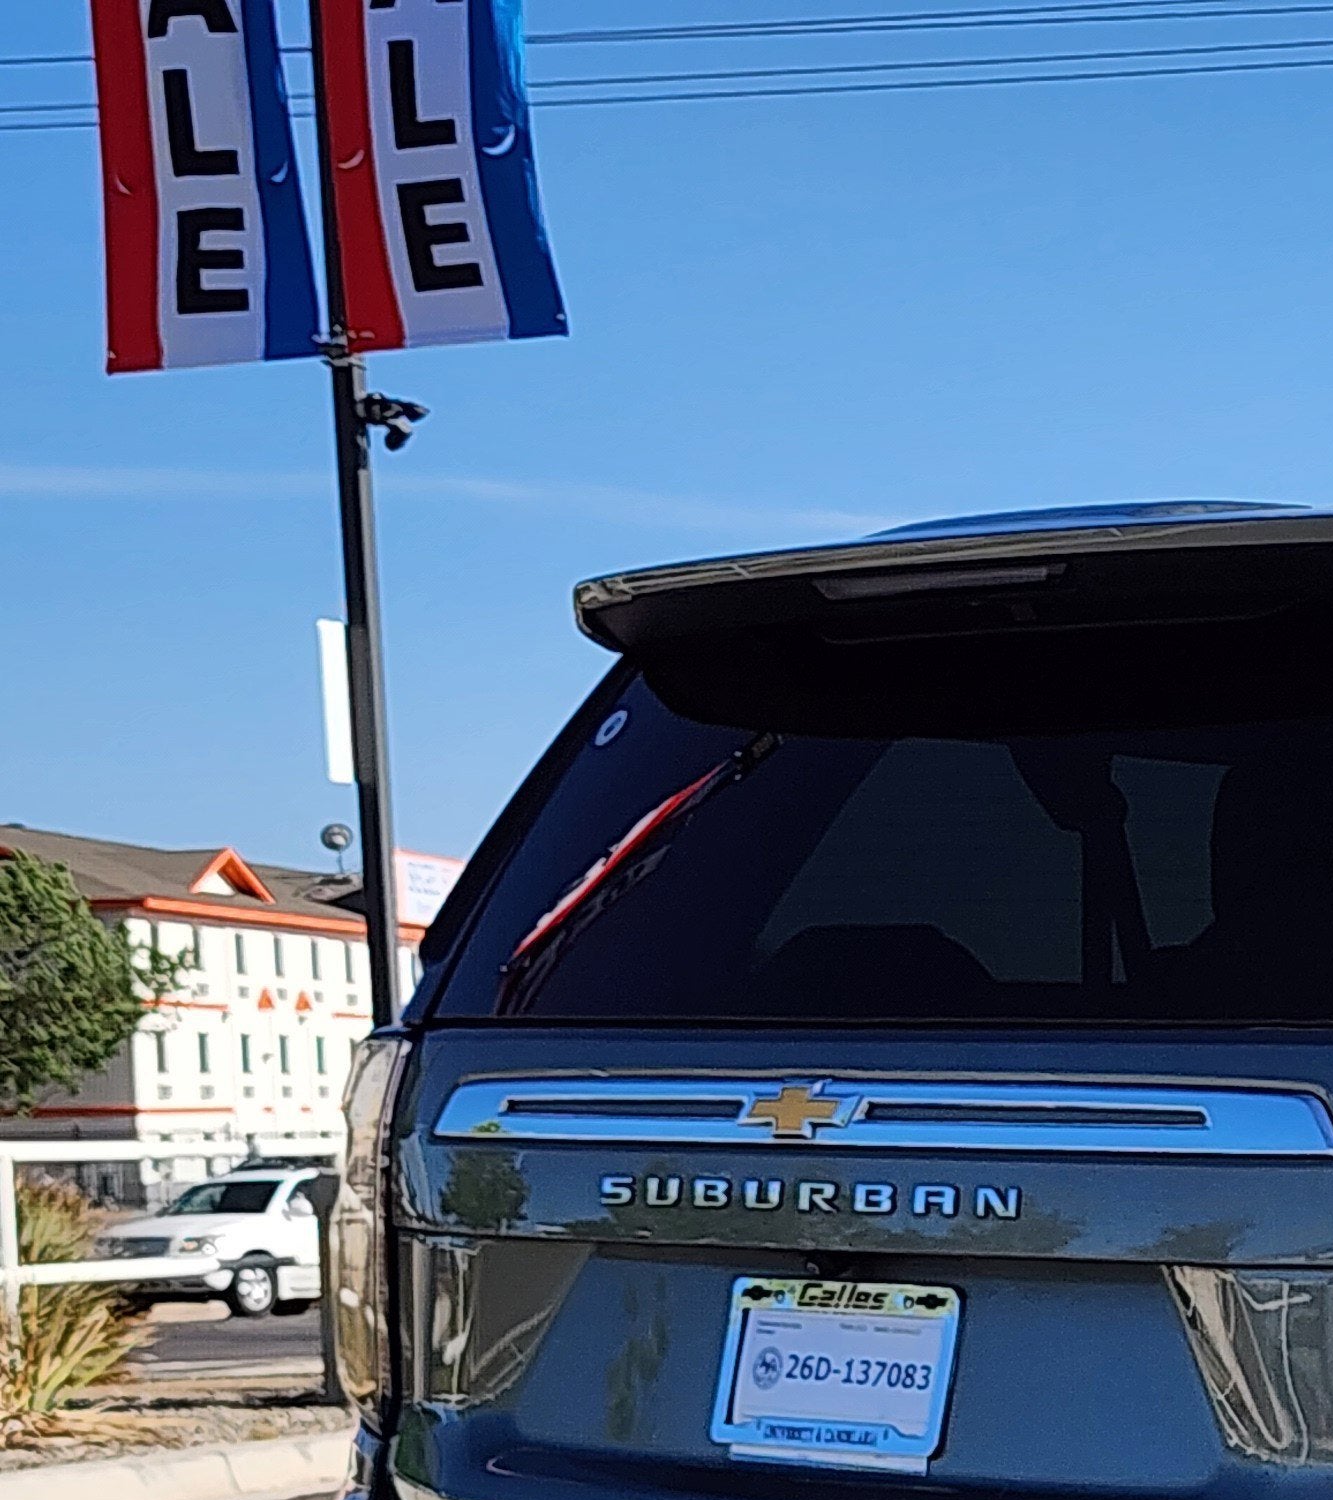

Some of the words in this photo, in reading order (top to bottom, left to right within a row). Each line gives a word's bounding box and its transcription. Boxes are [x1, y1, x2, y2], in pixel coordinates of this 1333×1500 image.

[370, 0, 484, 292] LE
[600, 1175, 1021, 1218] SUBURBAN
[784, 1353, 932, 1391] 26D-137083
